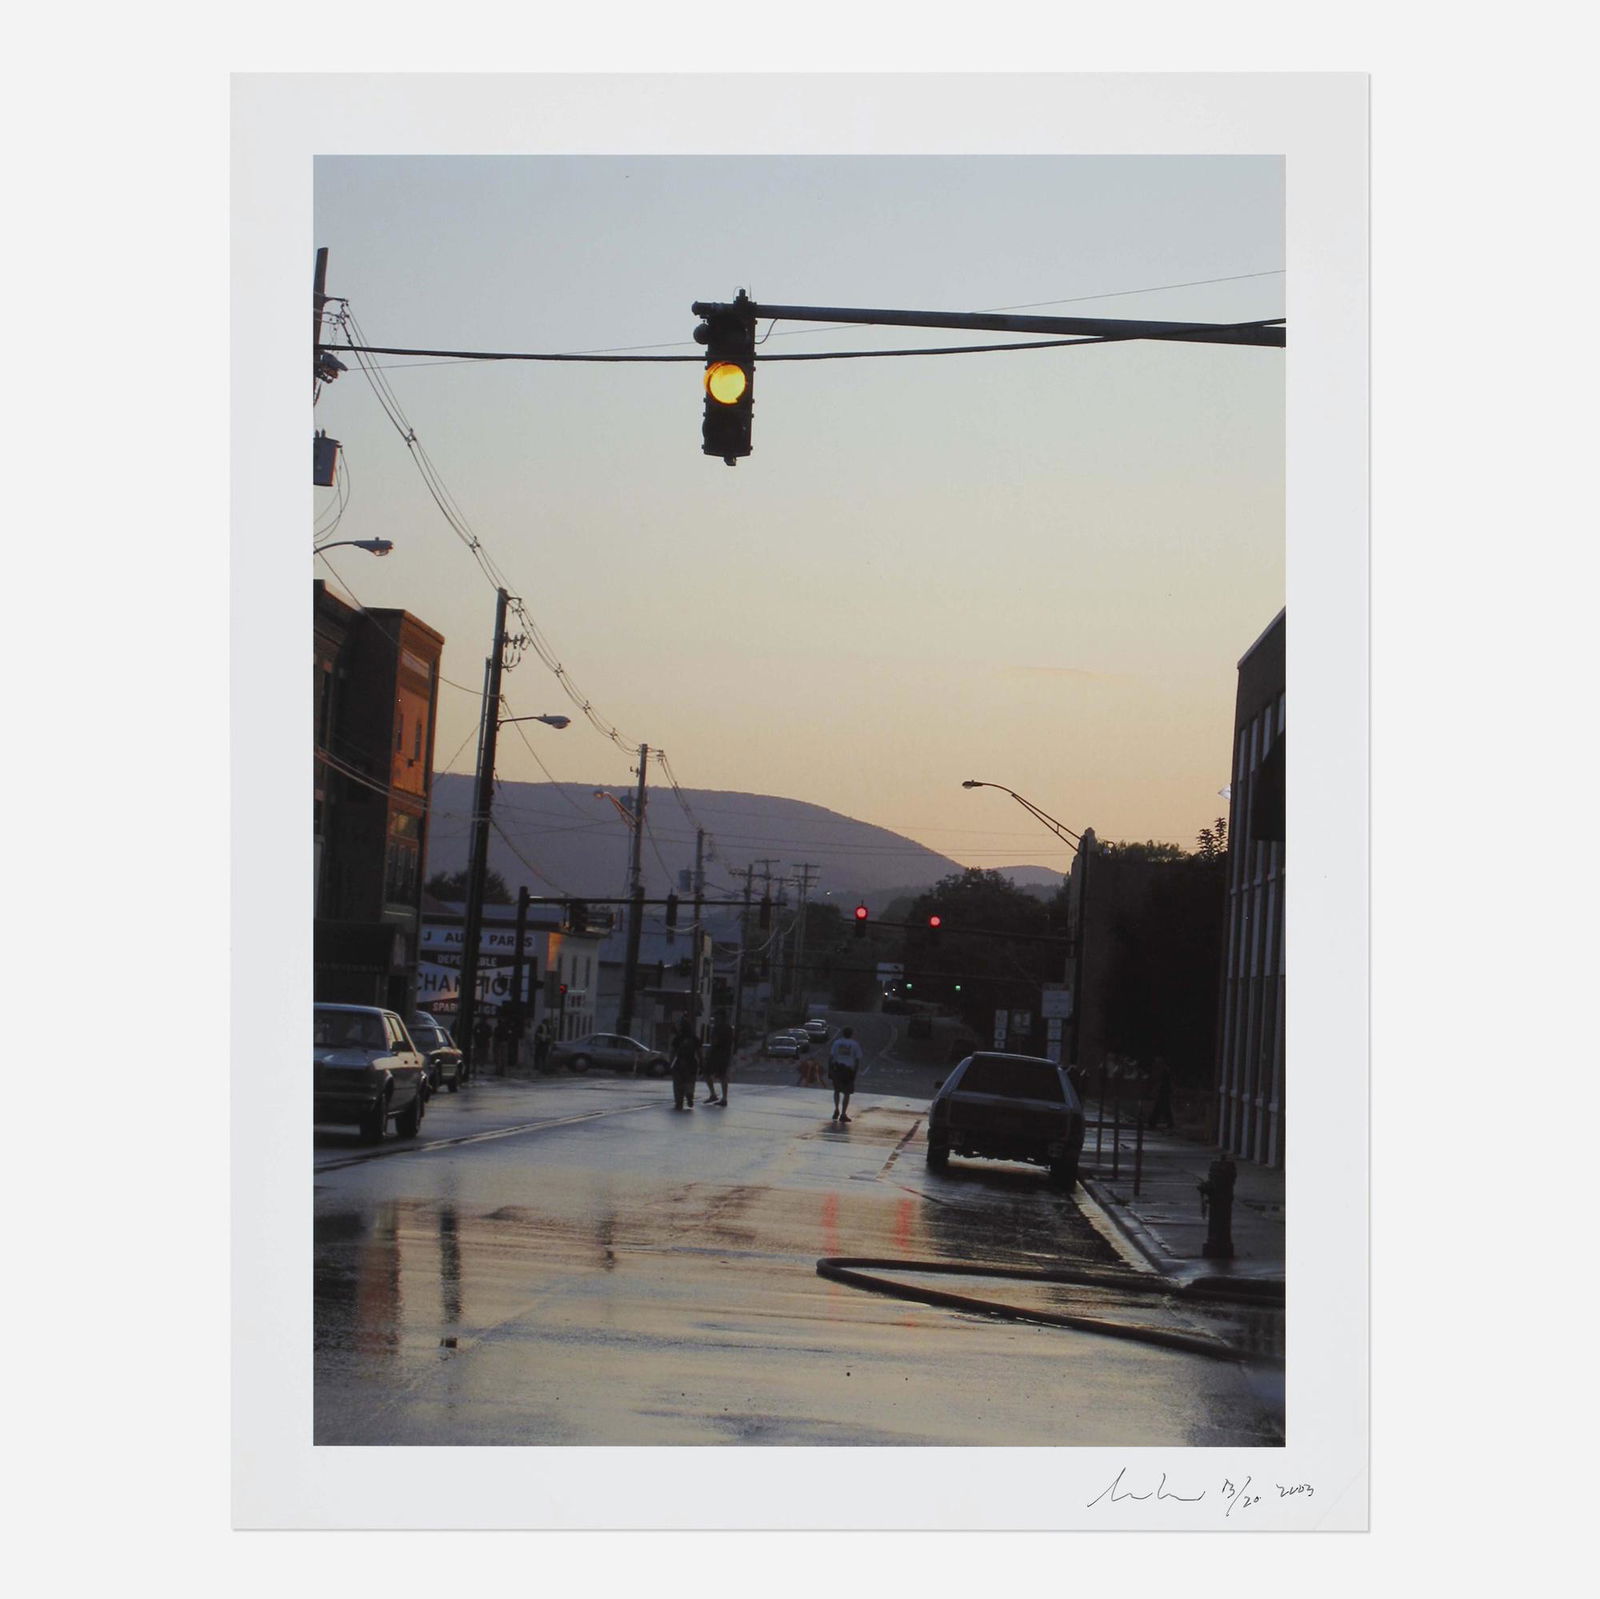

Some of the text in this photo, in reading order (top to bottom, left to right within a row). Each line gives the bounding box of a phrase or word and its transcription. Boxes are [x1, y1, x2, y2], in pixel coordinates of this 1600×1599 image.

[444, 932, 482, 944] AU
[489, 934, 533, 948] PARS
[438, 953, 497, 967] DEPEBLE
[415, 972, 513, 996] CHAMPIO
